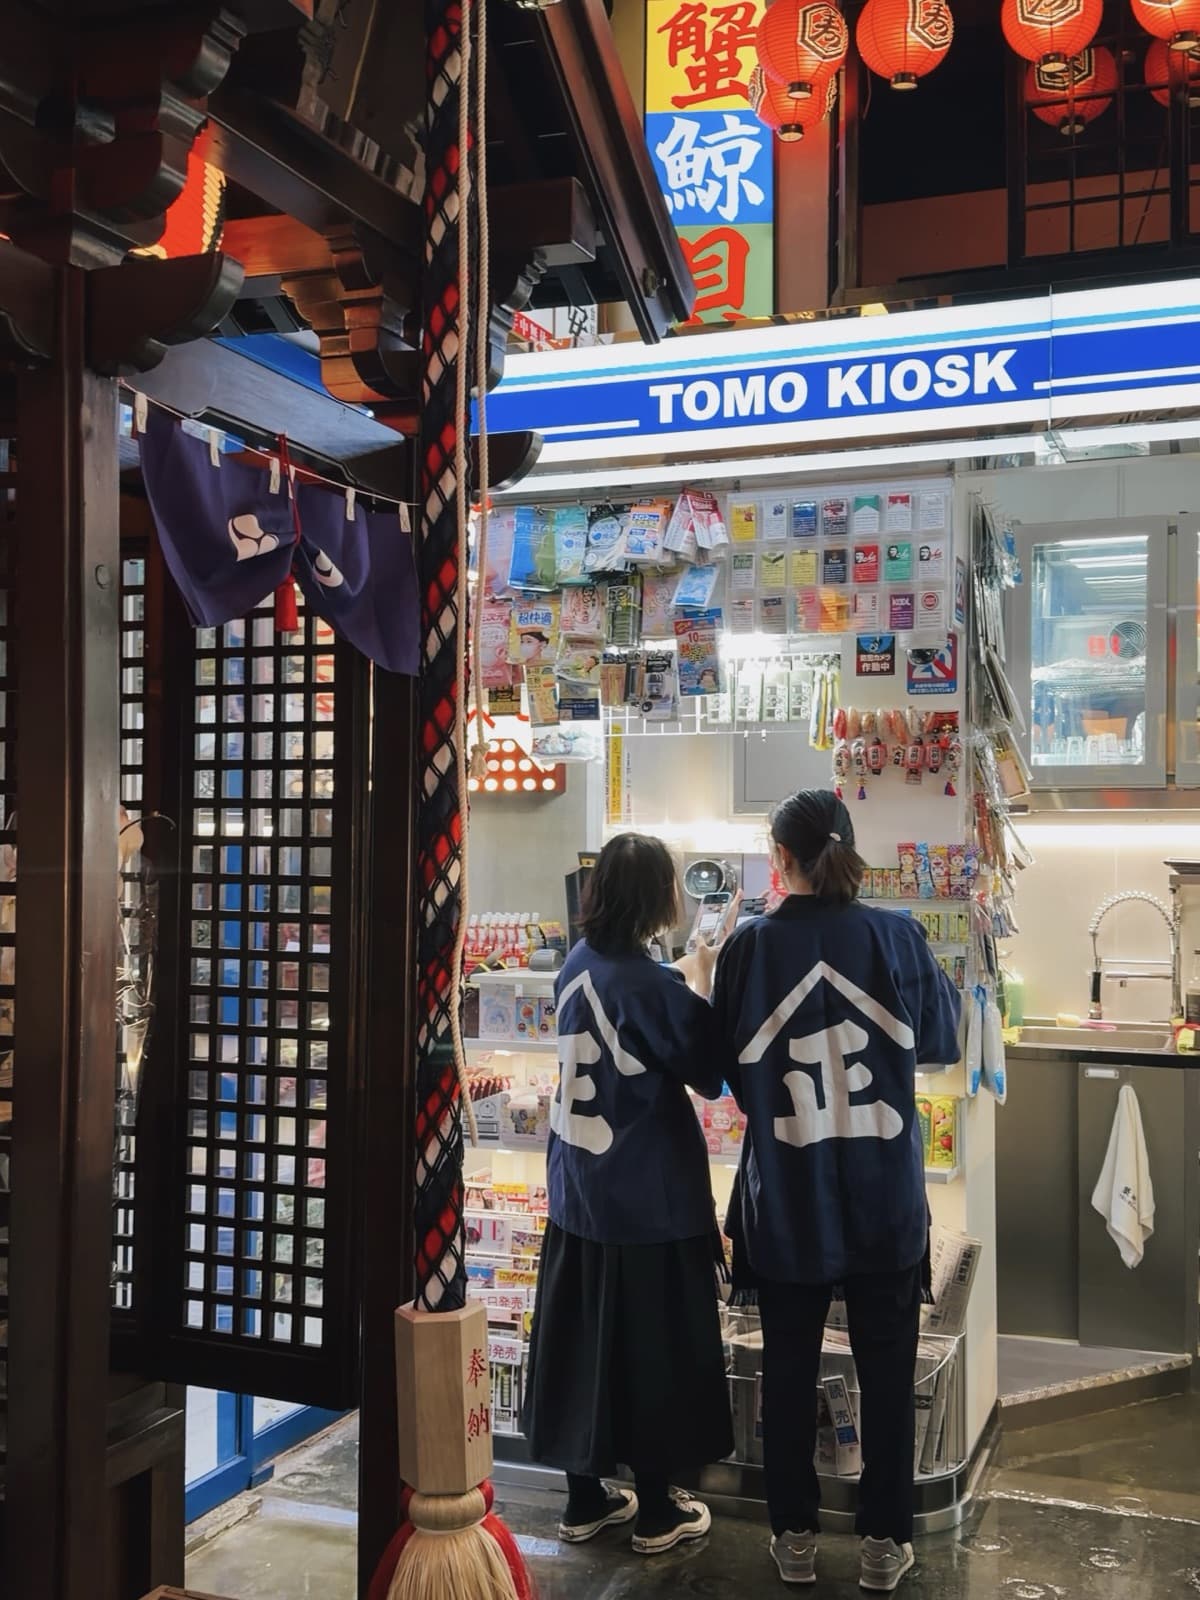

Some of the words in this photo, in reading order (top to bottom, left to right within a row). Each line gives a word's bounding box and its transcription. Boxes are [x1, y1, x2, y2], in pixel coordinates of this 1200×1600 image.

[655, 113, 765, 222] 鯨
[648, 371, 809, 425] TOMO
[827, 348, 1018, 409] KIOSK
[517, 611, 553, 625] 超快適
[466, 1348, 490, 1443] 奉納
